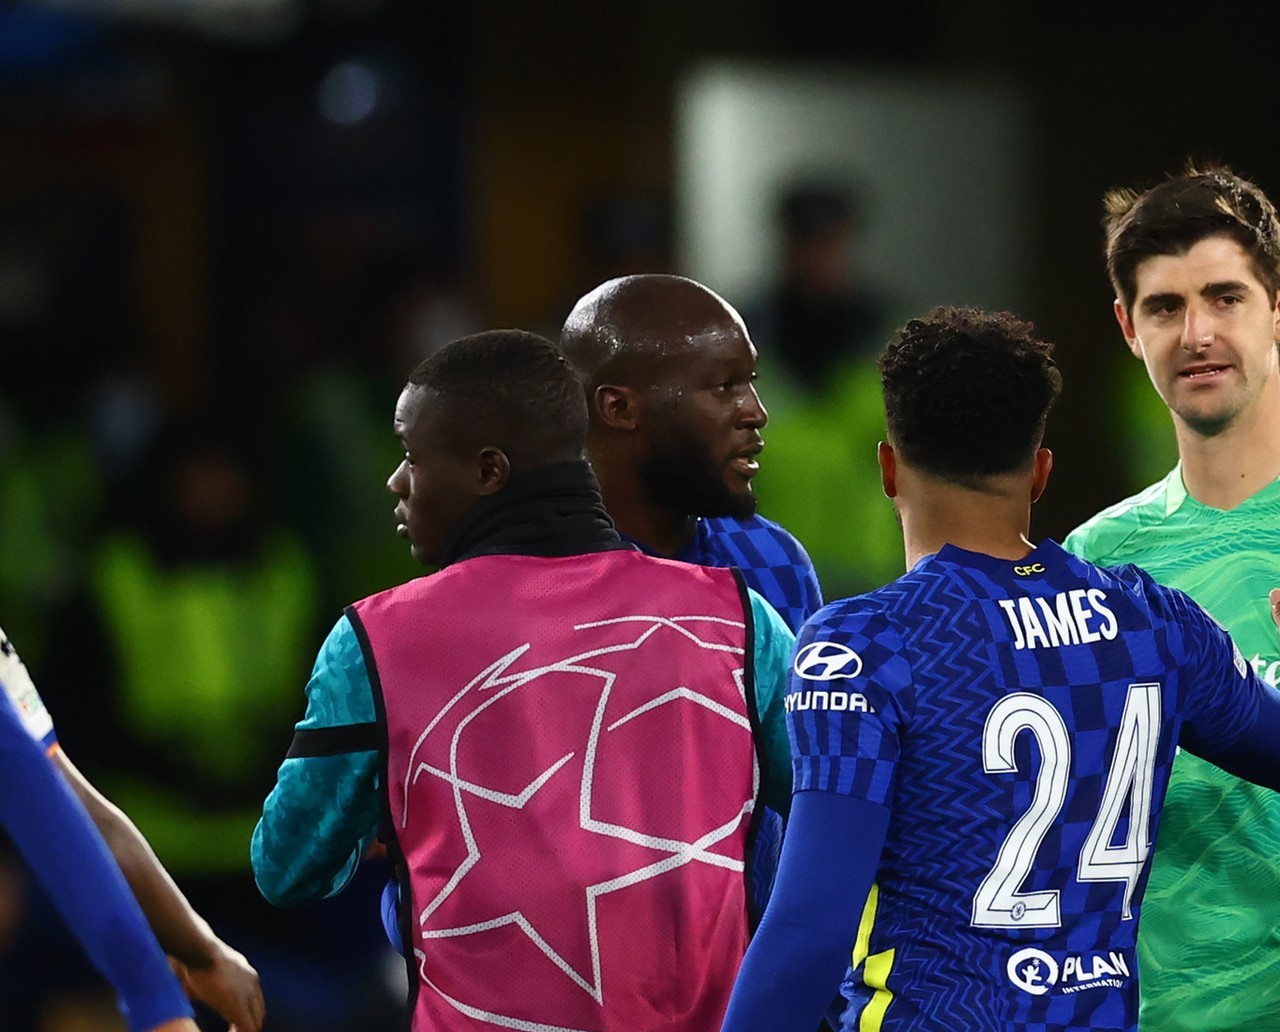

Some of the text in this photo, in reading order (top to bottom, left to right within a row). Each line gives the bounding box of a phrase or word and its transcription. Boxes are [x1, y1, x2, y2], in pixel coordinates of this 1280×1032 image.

[1014, 563, 1045, 576] CFC
[999, 588, 1118, 650] JAMES
[970, 682, 1162, 928] 24
[1062, 951, 1130, 982] PLAN
